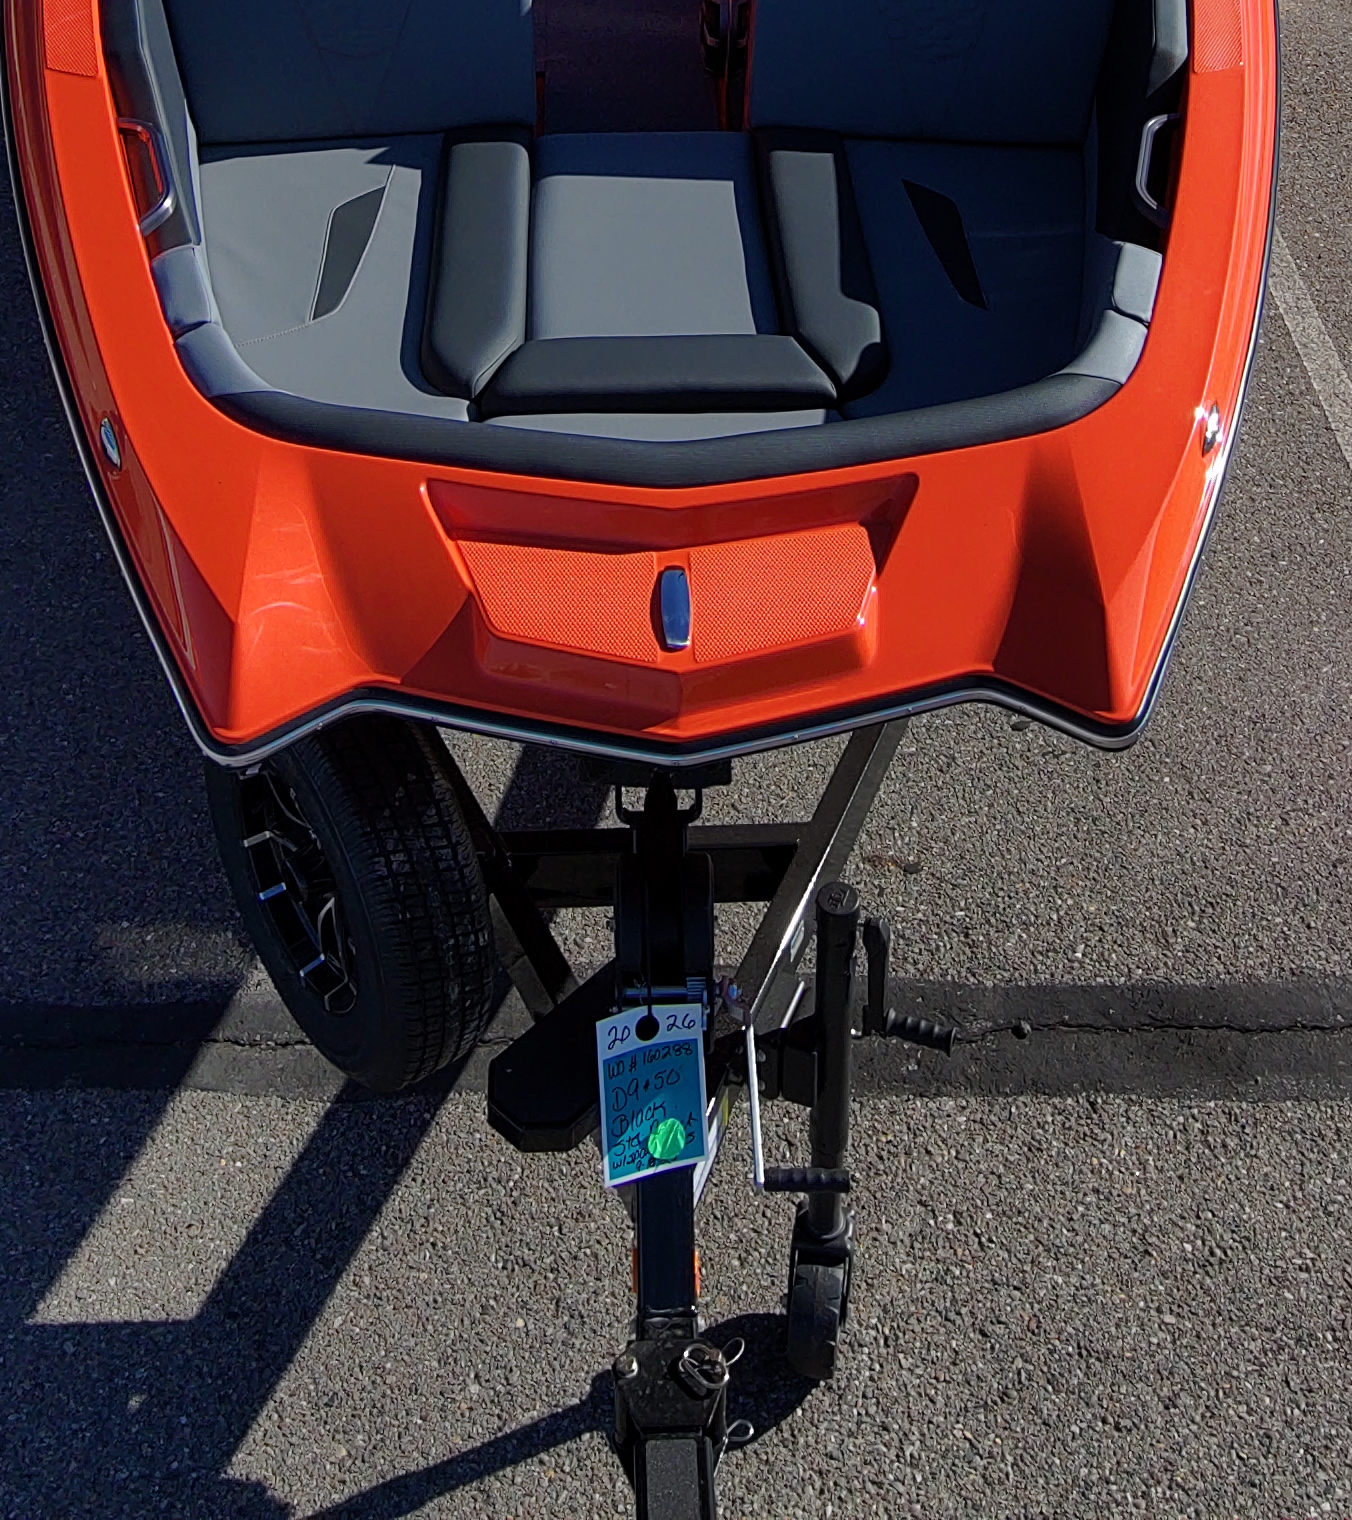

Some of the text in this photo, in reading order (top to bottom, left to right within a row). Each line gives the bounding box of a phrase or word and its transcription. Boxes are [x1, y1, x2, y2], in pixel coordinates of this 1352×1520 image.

[606, 1013, 696, 1051] 20 26
[611, 1101, 667, 1138] Black
